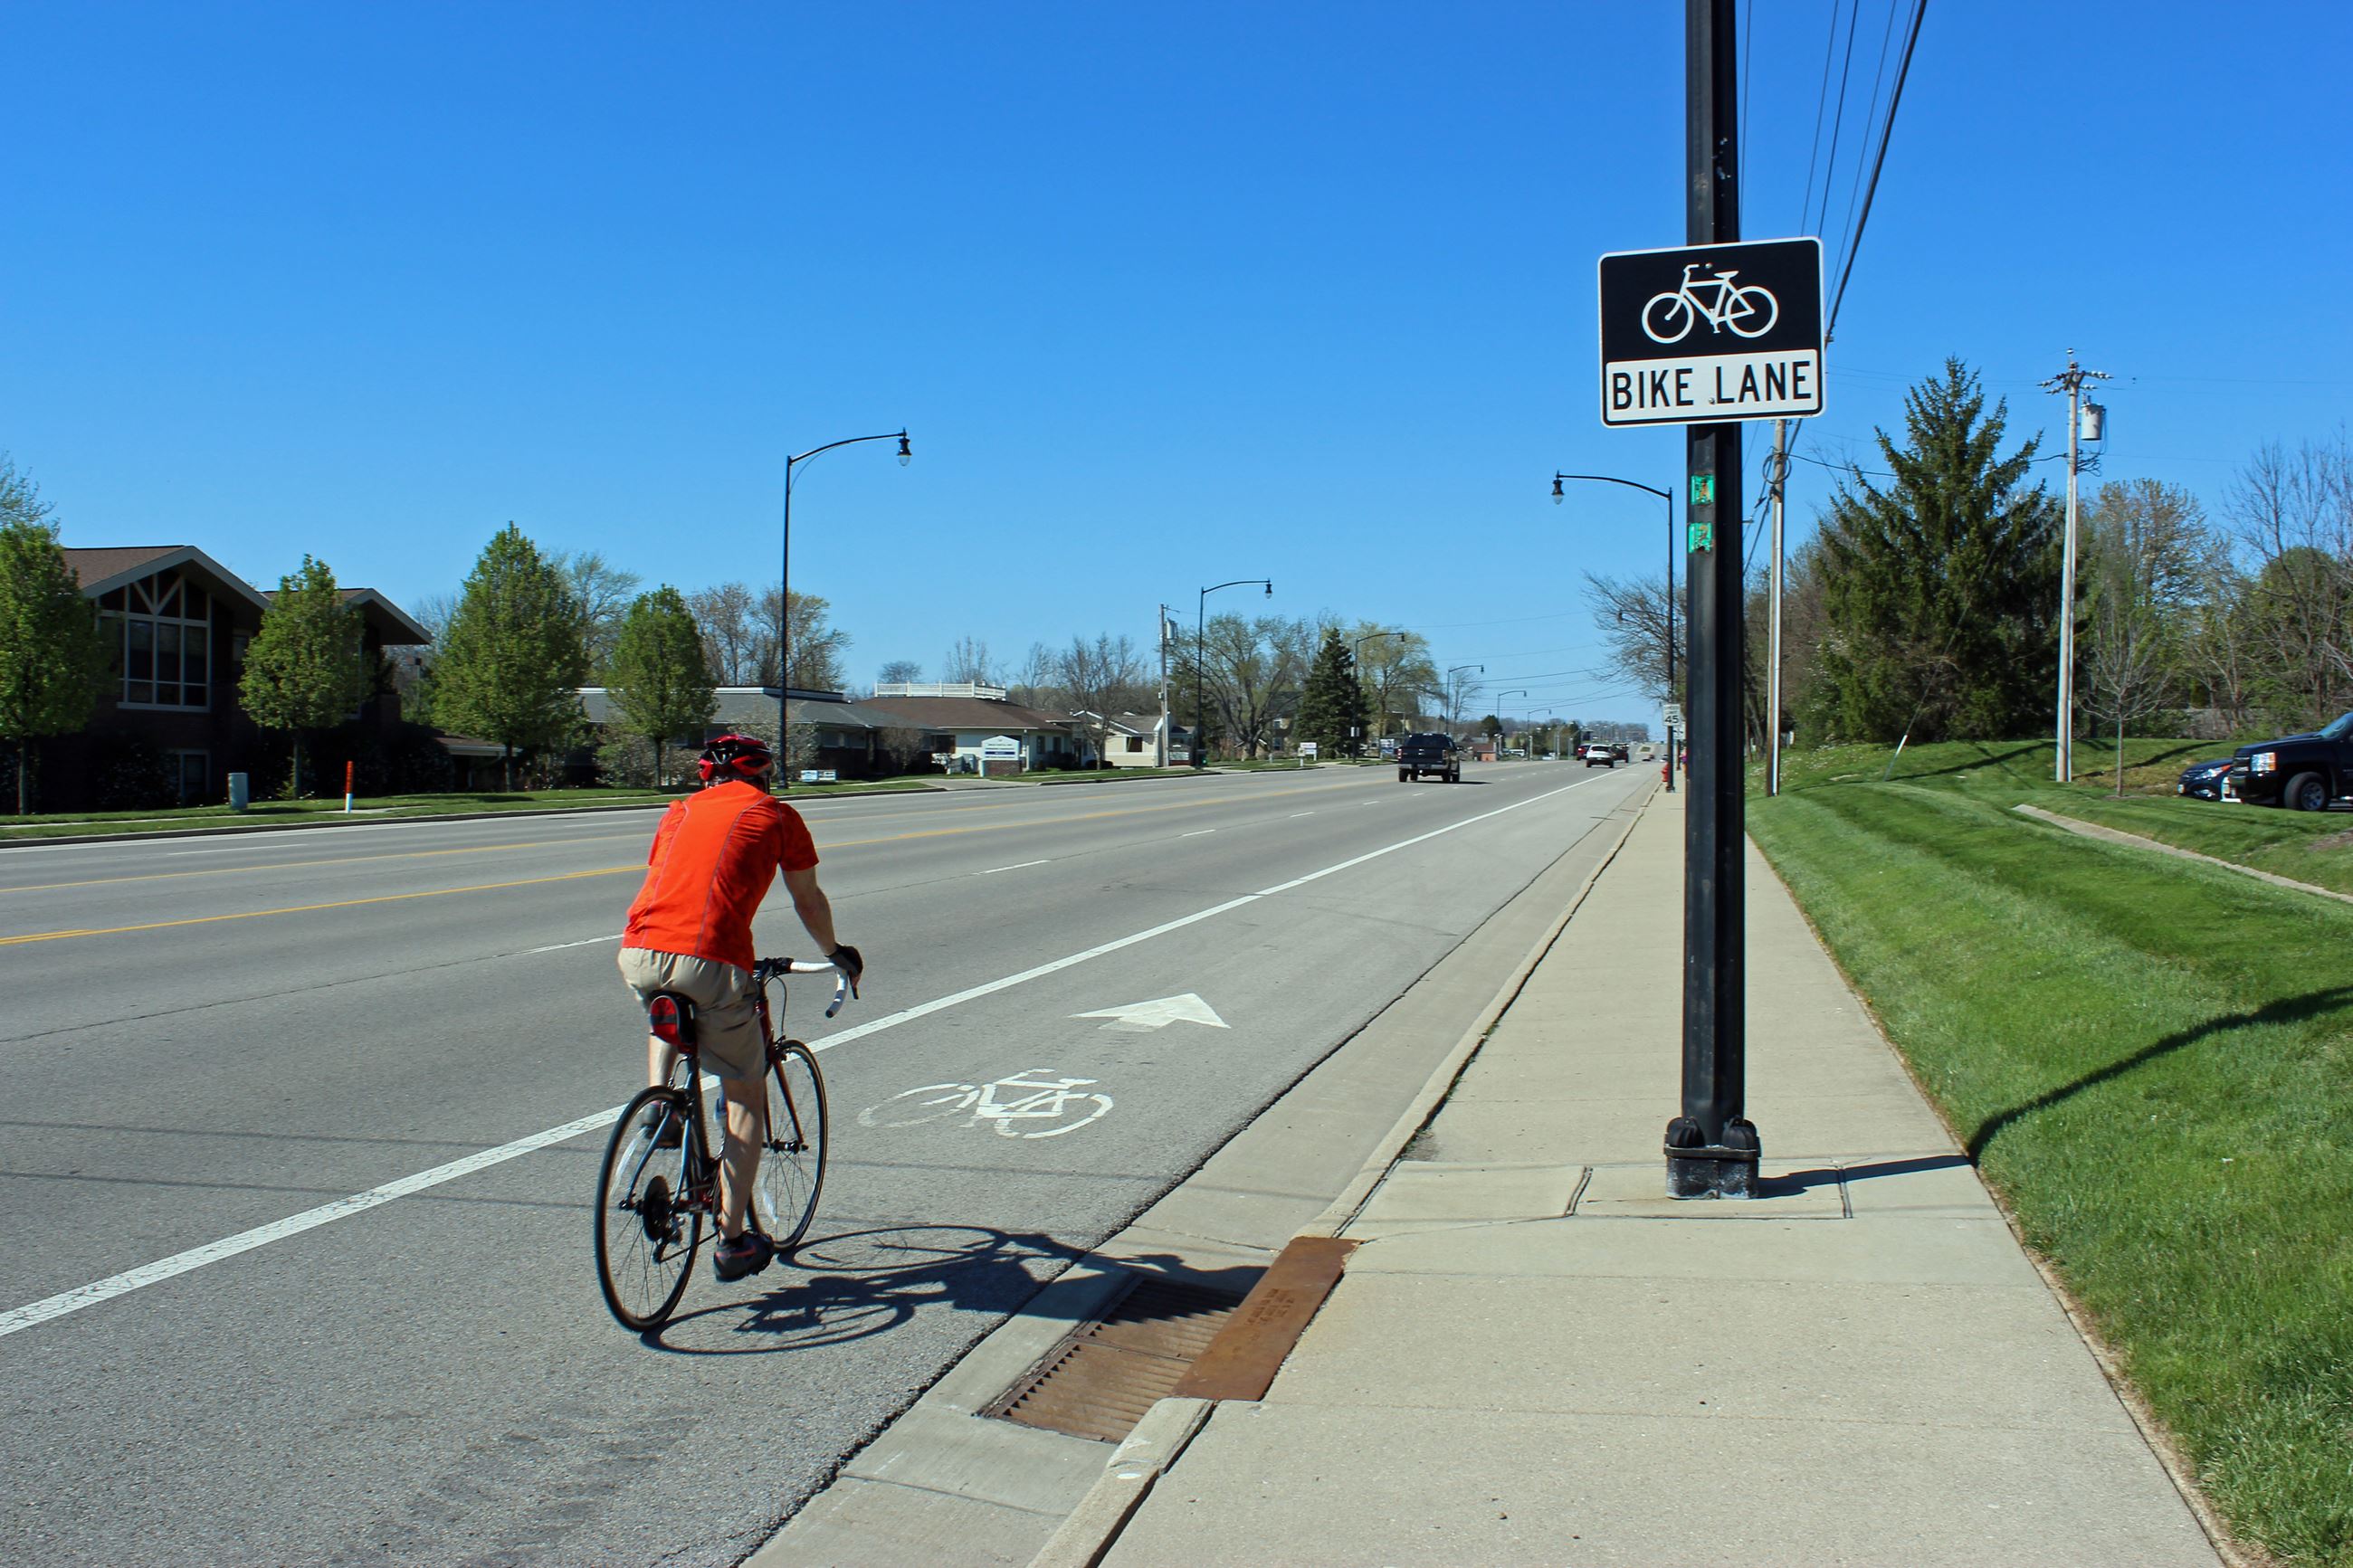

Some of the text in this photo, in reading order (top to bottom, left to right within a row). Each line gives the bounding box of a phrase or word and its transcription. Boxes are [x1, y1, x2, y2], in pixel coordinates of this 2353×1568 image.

[1613, 360, 1812, 410] BIKE LANE
[1664, 715, 1679, 724] 45
